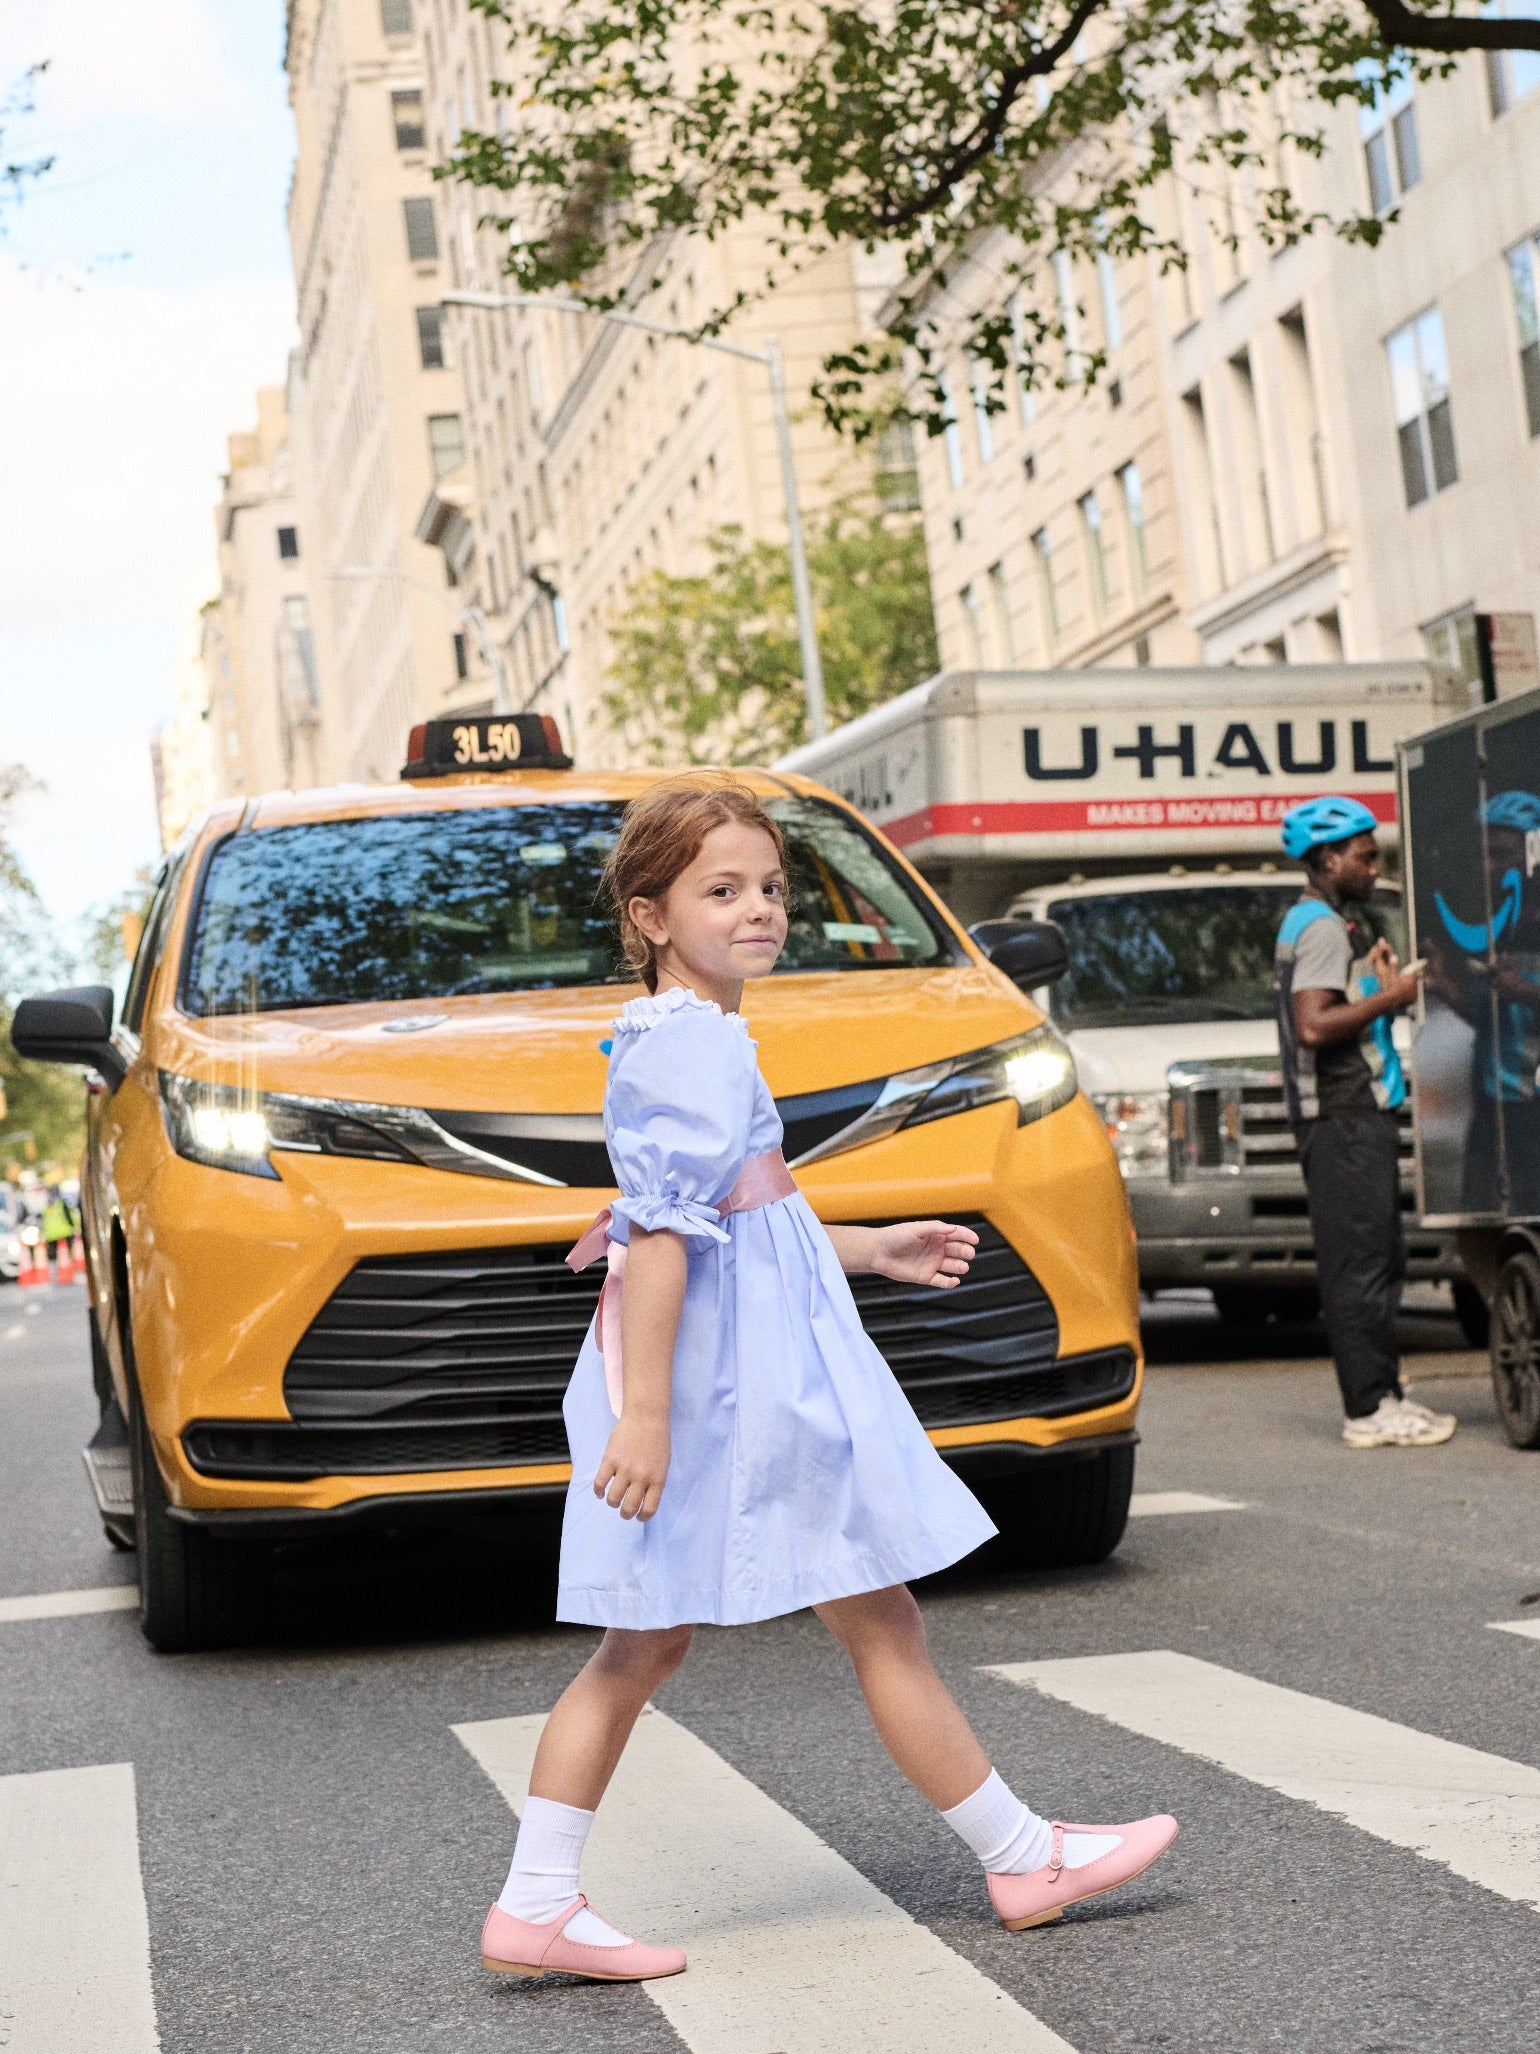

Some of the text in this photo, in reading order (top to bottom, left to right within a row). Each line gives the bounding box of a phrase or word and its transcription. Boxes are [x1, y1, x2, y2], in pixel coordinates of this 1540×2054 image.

[453, 723, 521, 764] 3L50
[1087, 803, 1164, 825] MAKES
[1167, 800, 1257, 823] MOVING
